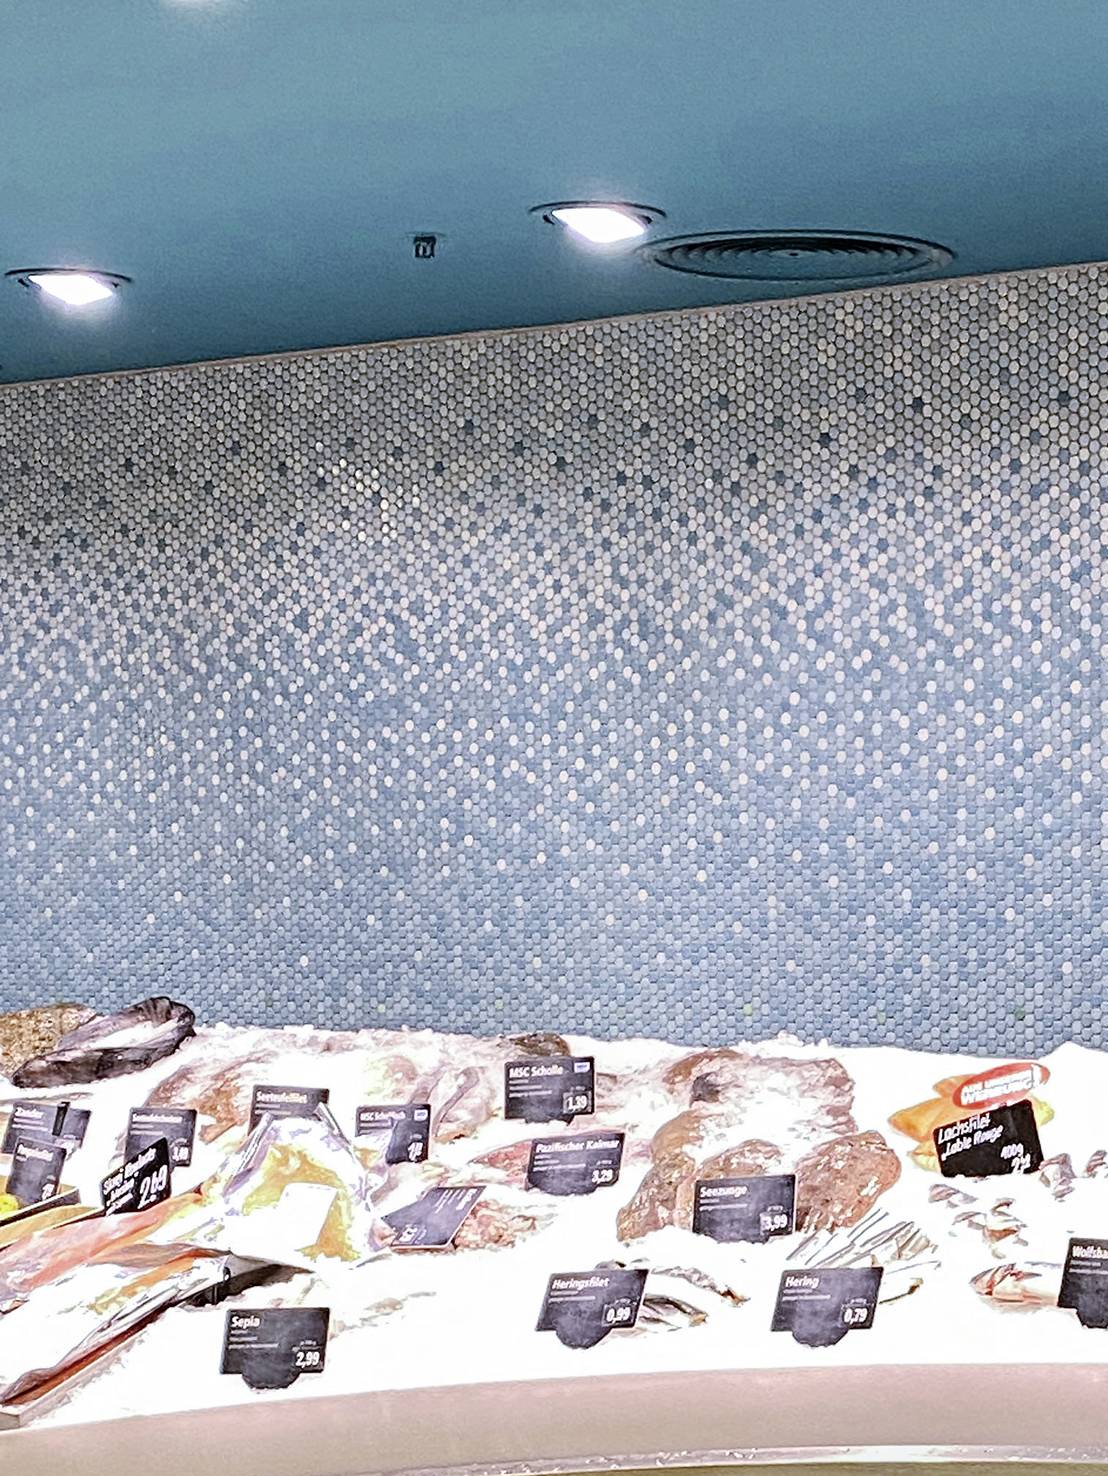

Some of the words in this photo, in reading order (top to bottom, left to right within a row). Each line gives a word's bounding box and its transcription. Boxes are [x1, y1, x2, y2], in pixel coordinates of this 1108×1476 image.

[509, 1067, 530, 1078] MSC
[531, 1064, 563, 1077] Scholle
[586, 1139, 620, 1150] Kalmar
[700, 1185, 748, 1198] Seezunge
[552, 1276, 610, 1292] Heringsfilet
[785, 1275, 820, 1288] Hering
[231, 1315, 260, 1329] Sepia
[295, 1351, 320, 1368] 2,99
